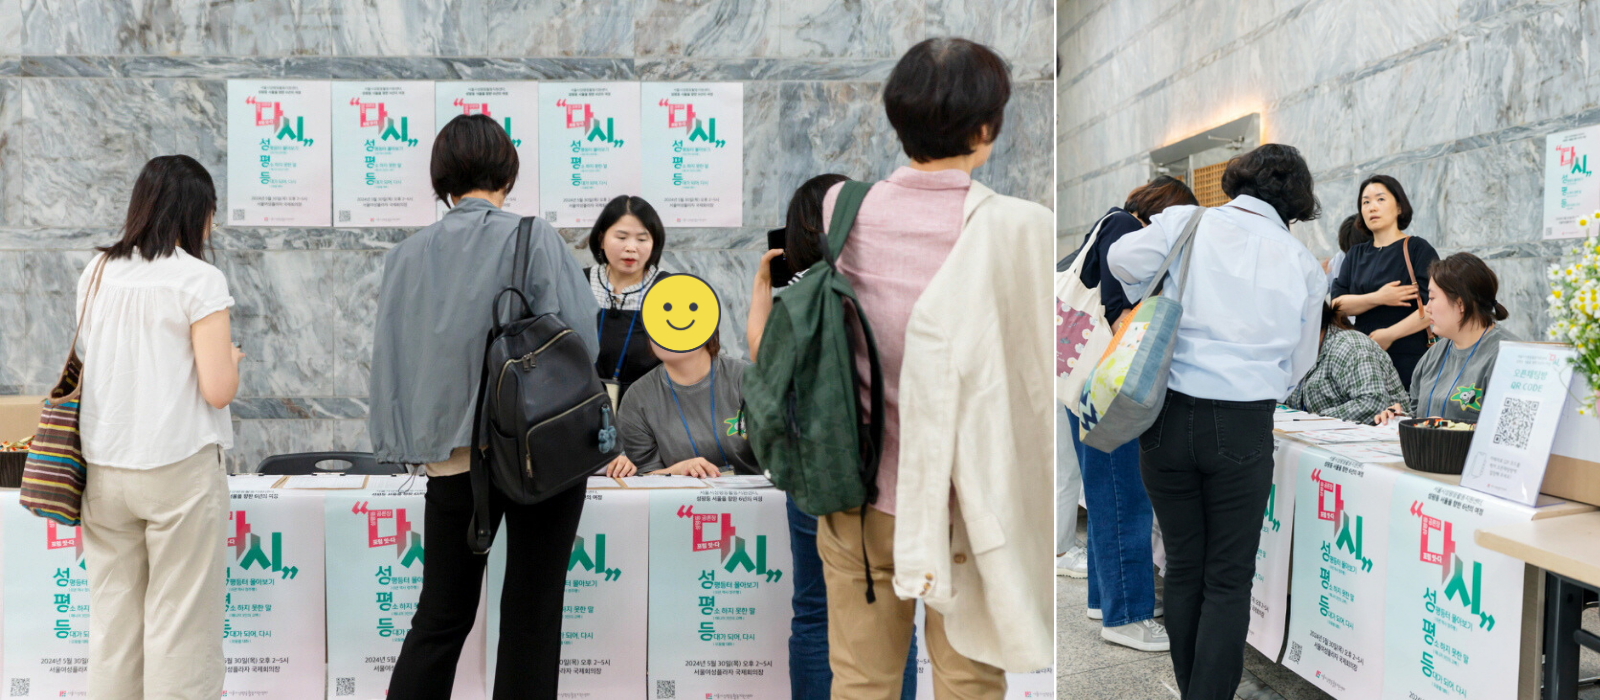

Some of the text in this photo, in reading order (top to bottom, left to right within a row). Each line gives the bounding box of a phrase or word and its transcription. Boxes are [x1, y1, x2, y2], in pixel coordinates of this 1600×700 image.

[1511, 382, 1543, 392] QR CODE
[1321, 540, 1330, 562] 성
[53, 568, 70, 587] 성
[375, 566, 392, 585] 성
[698, 570, 714, 589] 성
[1320, 567, 1330, 590] 평
[54, 594, 70, 613] 평
[376, 592, 392, 611] 평
[698, 596, 714, 615] 평
[1319, 595, 1329, 617] 등
[1423, 587, 1436, 613] 성
[54, 620, 71, 638] 등
[230, 630, 242, 638] 대가
[259, 630, 271, 638] 다시
[377, 618, 394, 637] 등
[698, 622, 715, 641] 등
[1422, 618, 1436, 645] 평
[1440, 642, 1450, 654] 하지
[1452, 648, 1462, 661] 못한
[1420, 651, 1434, 677] 등
[1433, 671, 1442, 684] 대가
[1456, 684, 1467, 698] 다시
